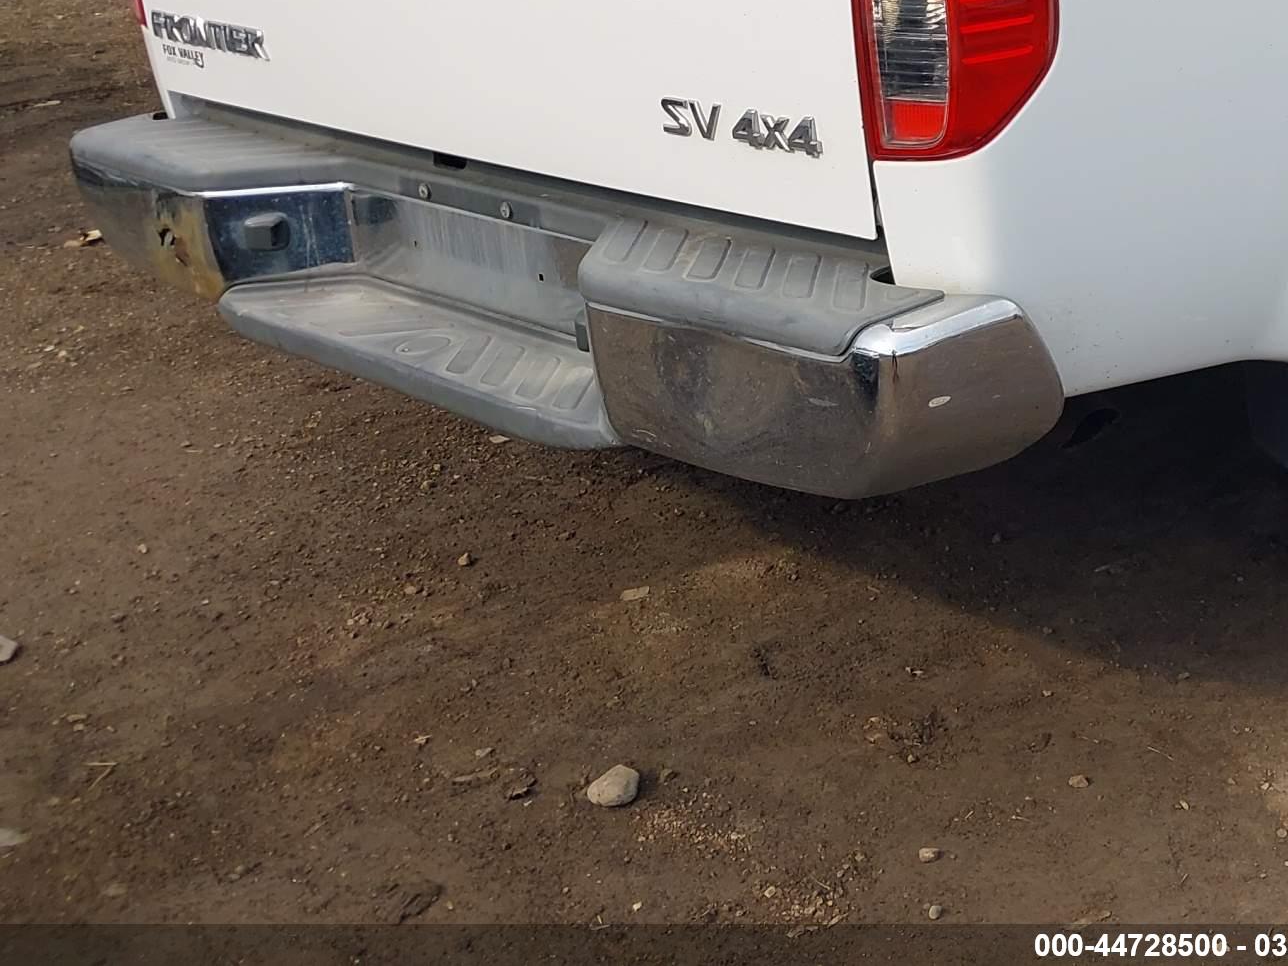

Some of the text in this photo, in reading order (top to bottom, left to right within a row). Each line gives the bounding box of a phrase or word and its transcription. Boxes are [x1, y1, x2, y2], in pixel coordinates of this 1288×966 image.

[151, 10, 270, 62] FRONTIER
[162, 44, 176, 56] FOX
[177, 48, 204, 68] VALLEY
[661, 97, 722, 141] SV
